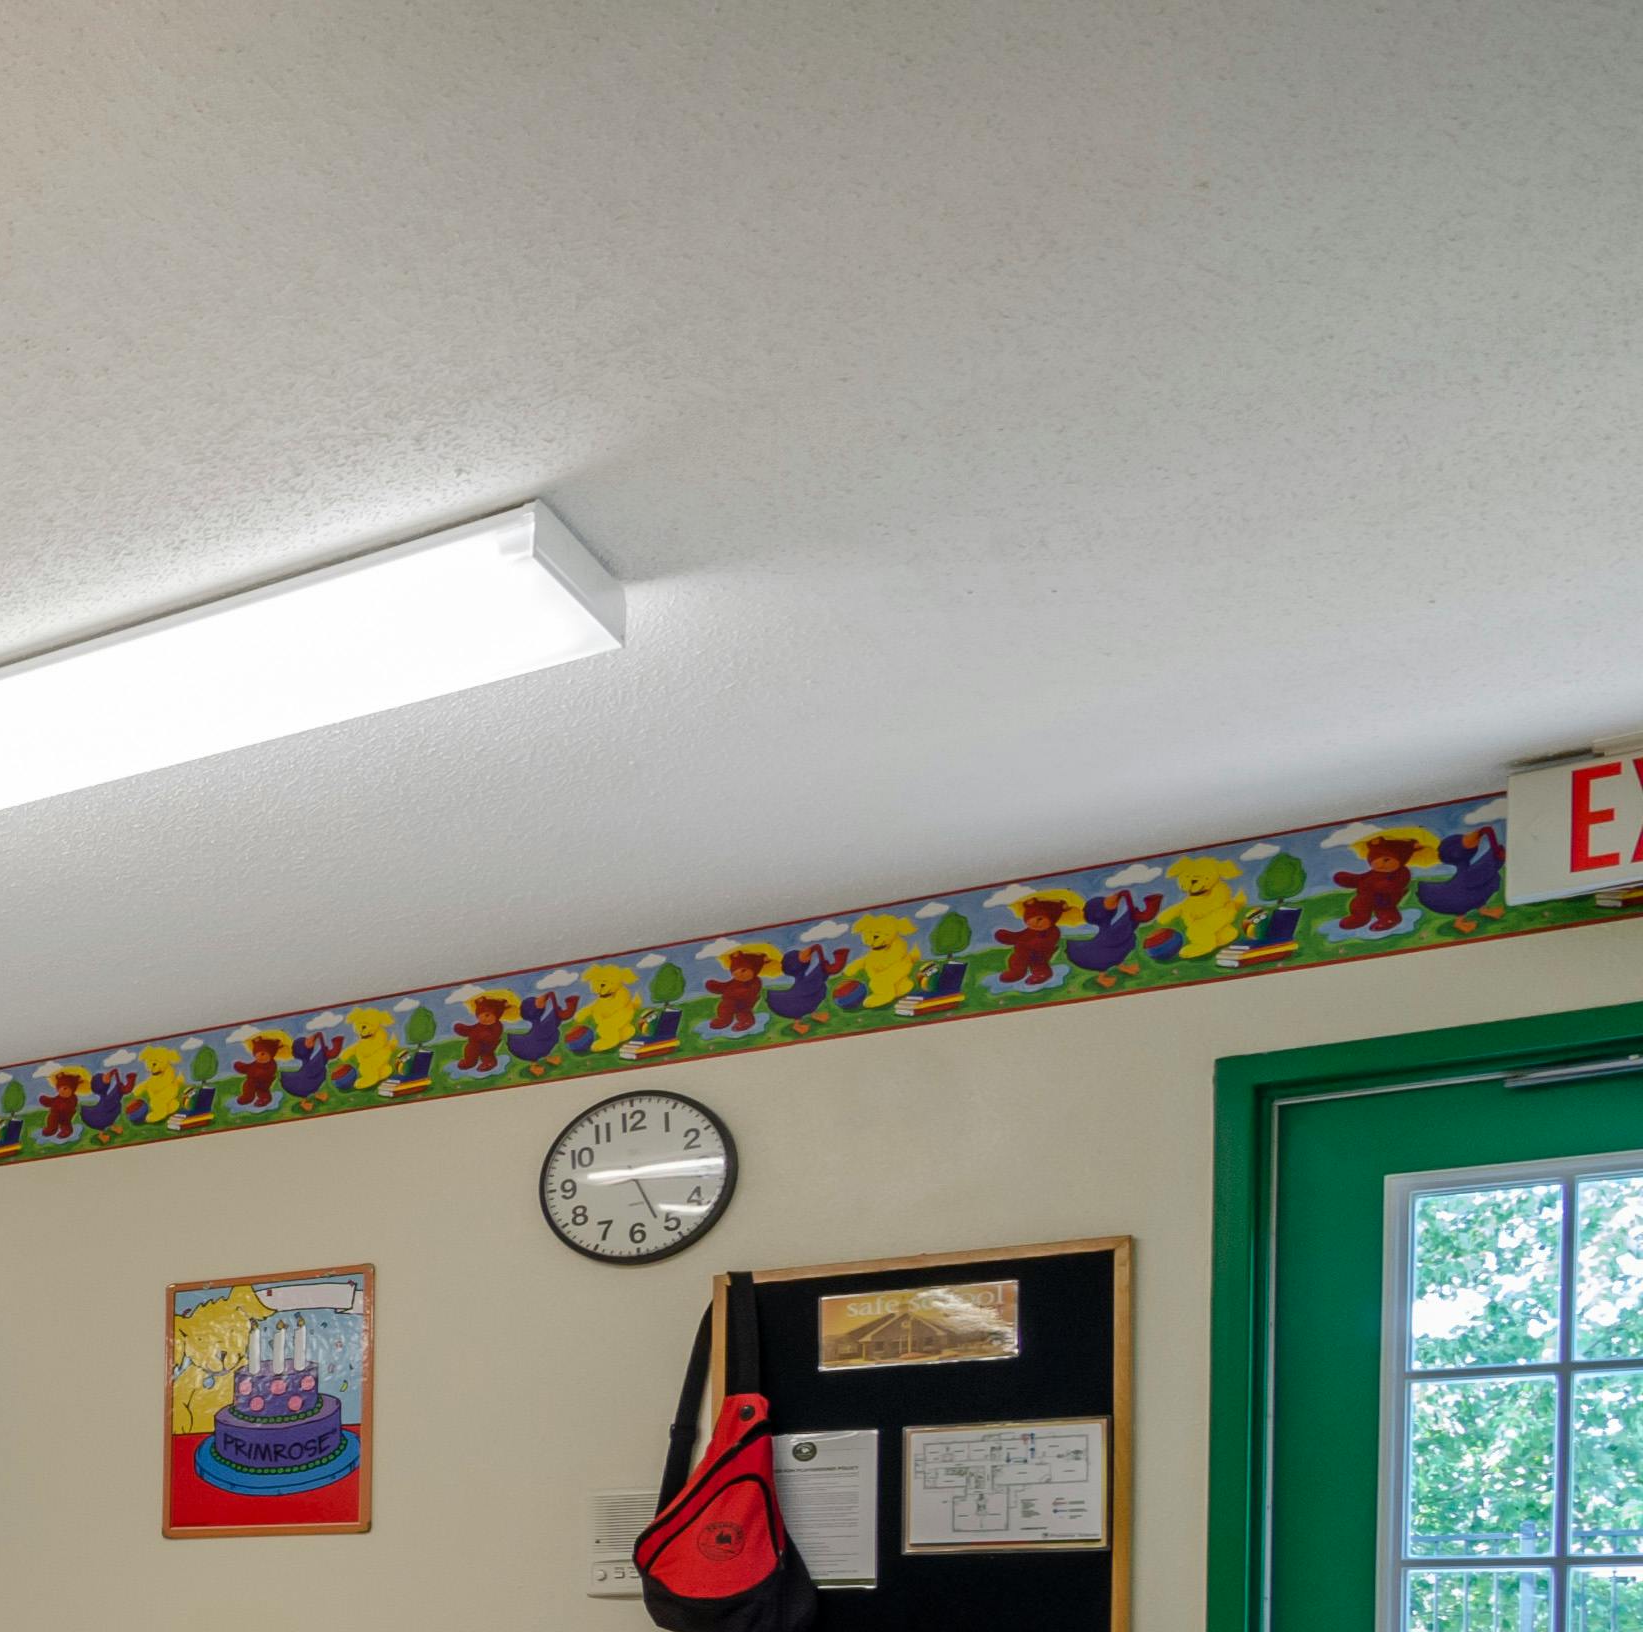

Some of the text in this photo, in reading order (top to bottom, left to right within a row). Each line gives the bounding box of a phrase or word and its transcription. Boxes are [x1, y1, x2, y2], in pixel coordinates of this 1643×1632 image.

[621, 1109, 647, 1134] 12
[664, 1111, 670, 1133] 1
[594, 1122, 612, 1145] 11
[683, 1127, 701, 1150] 2
[570, 1146, 595, 1170] 10
[560, 1178, 577, 1200] 9
[686, 1185, 703, 1207] 4
[571, 1204, 589, 1226] 8
[663, 1211, 682, 1232] 5
[597, 1219, 614, 1241] 7
[628, 1222, 647, 1244] 6
[846, 1295, 901, 1318] safe
